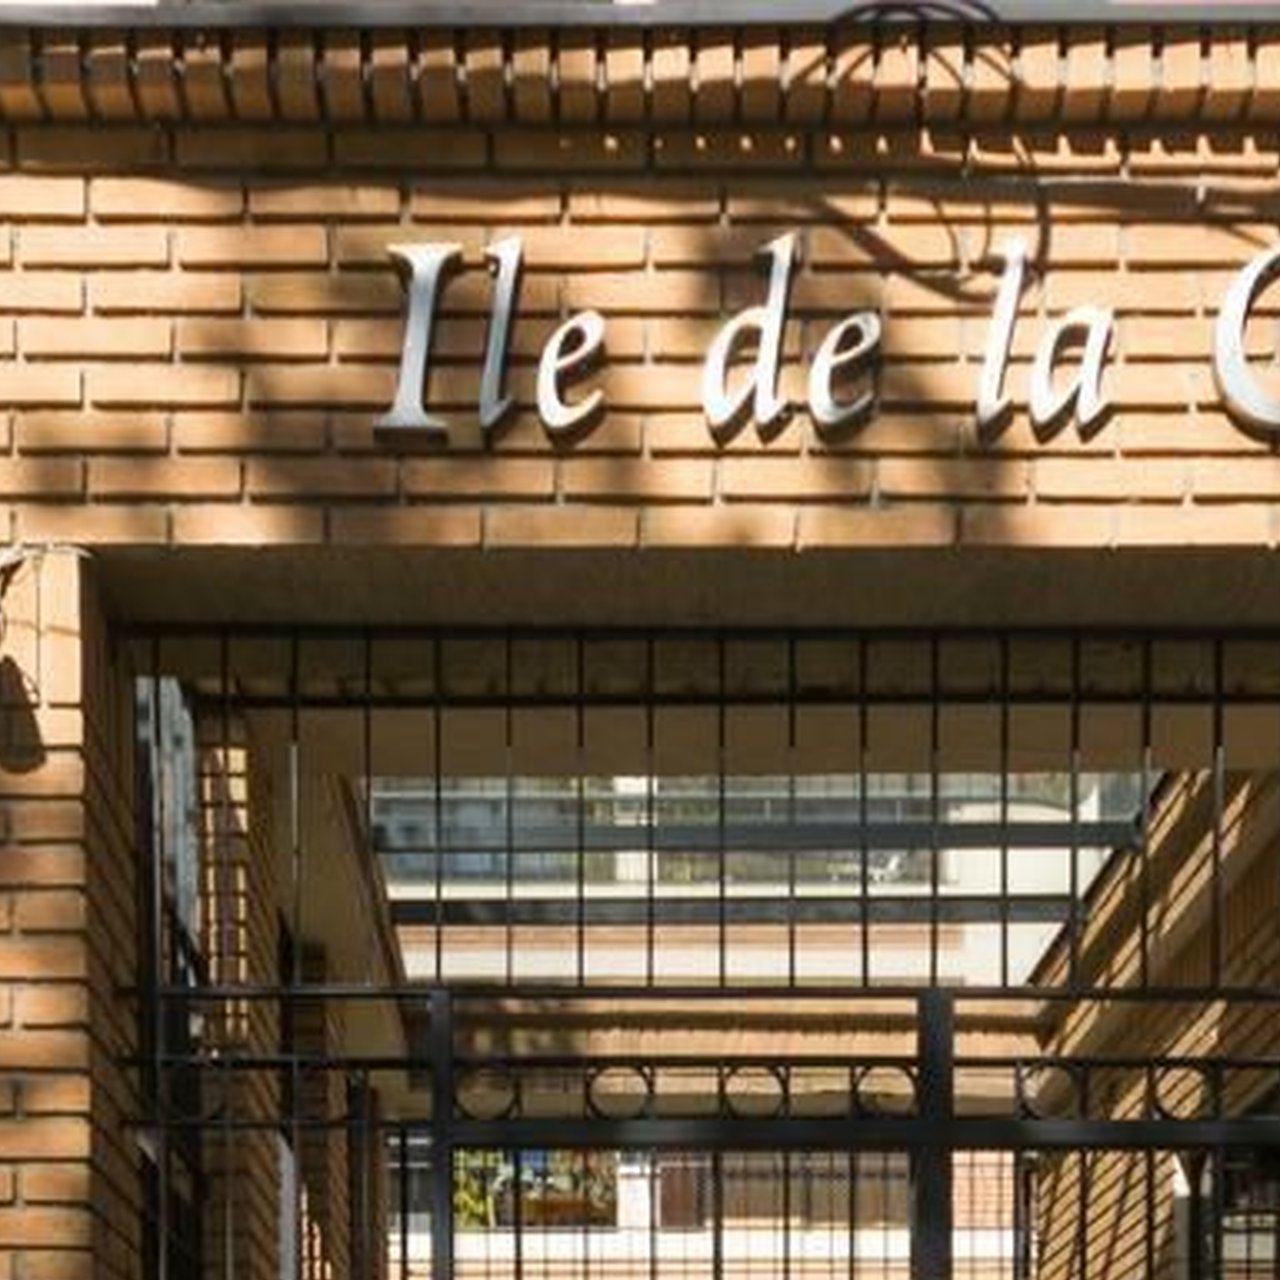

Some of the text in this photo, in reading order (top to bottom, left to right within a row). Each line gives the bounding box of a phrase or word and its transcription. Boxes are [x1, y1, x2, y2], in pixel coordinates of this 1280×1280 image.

[372, 234, 606, 430] Ile
[701, 231, 883, 426] de
[976, 235, 1116, 426] la
